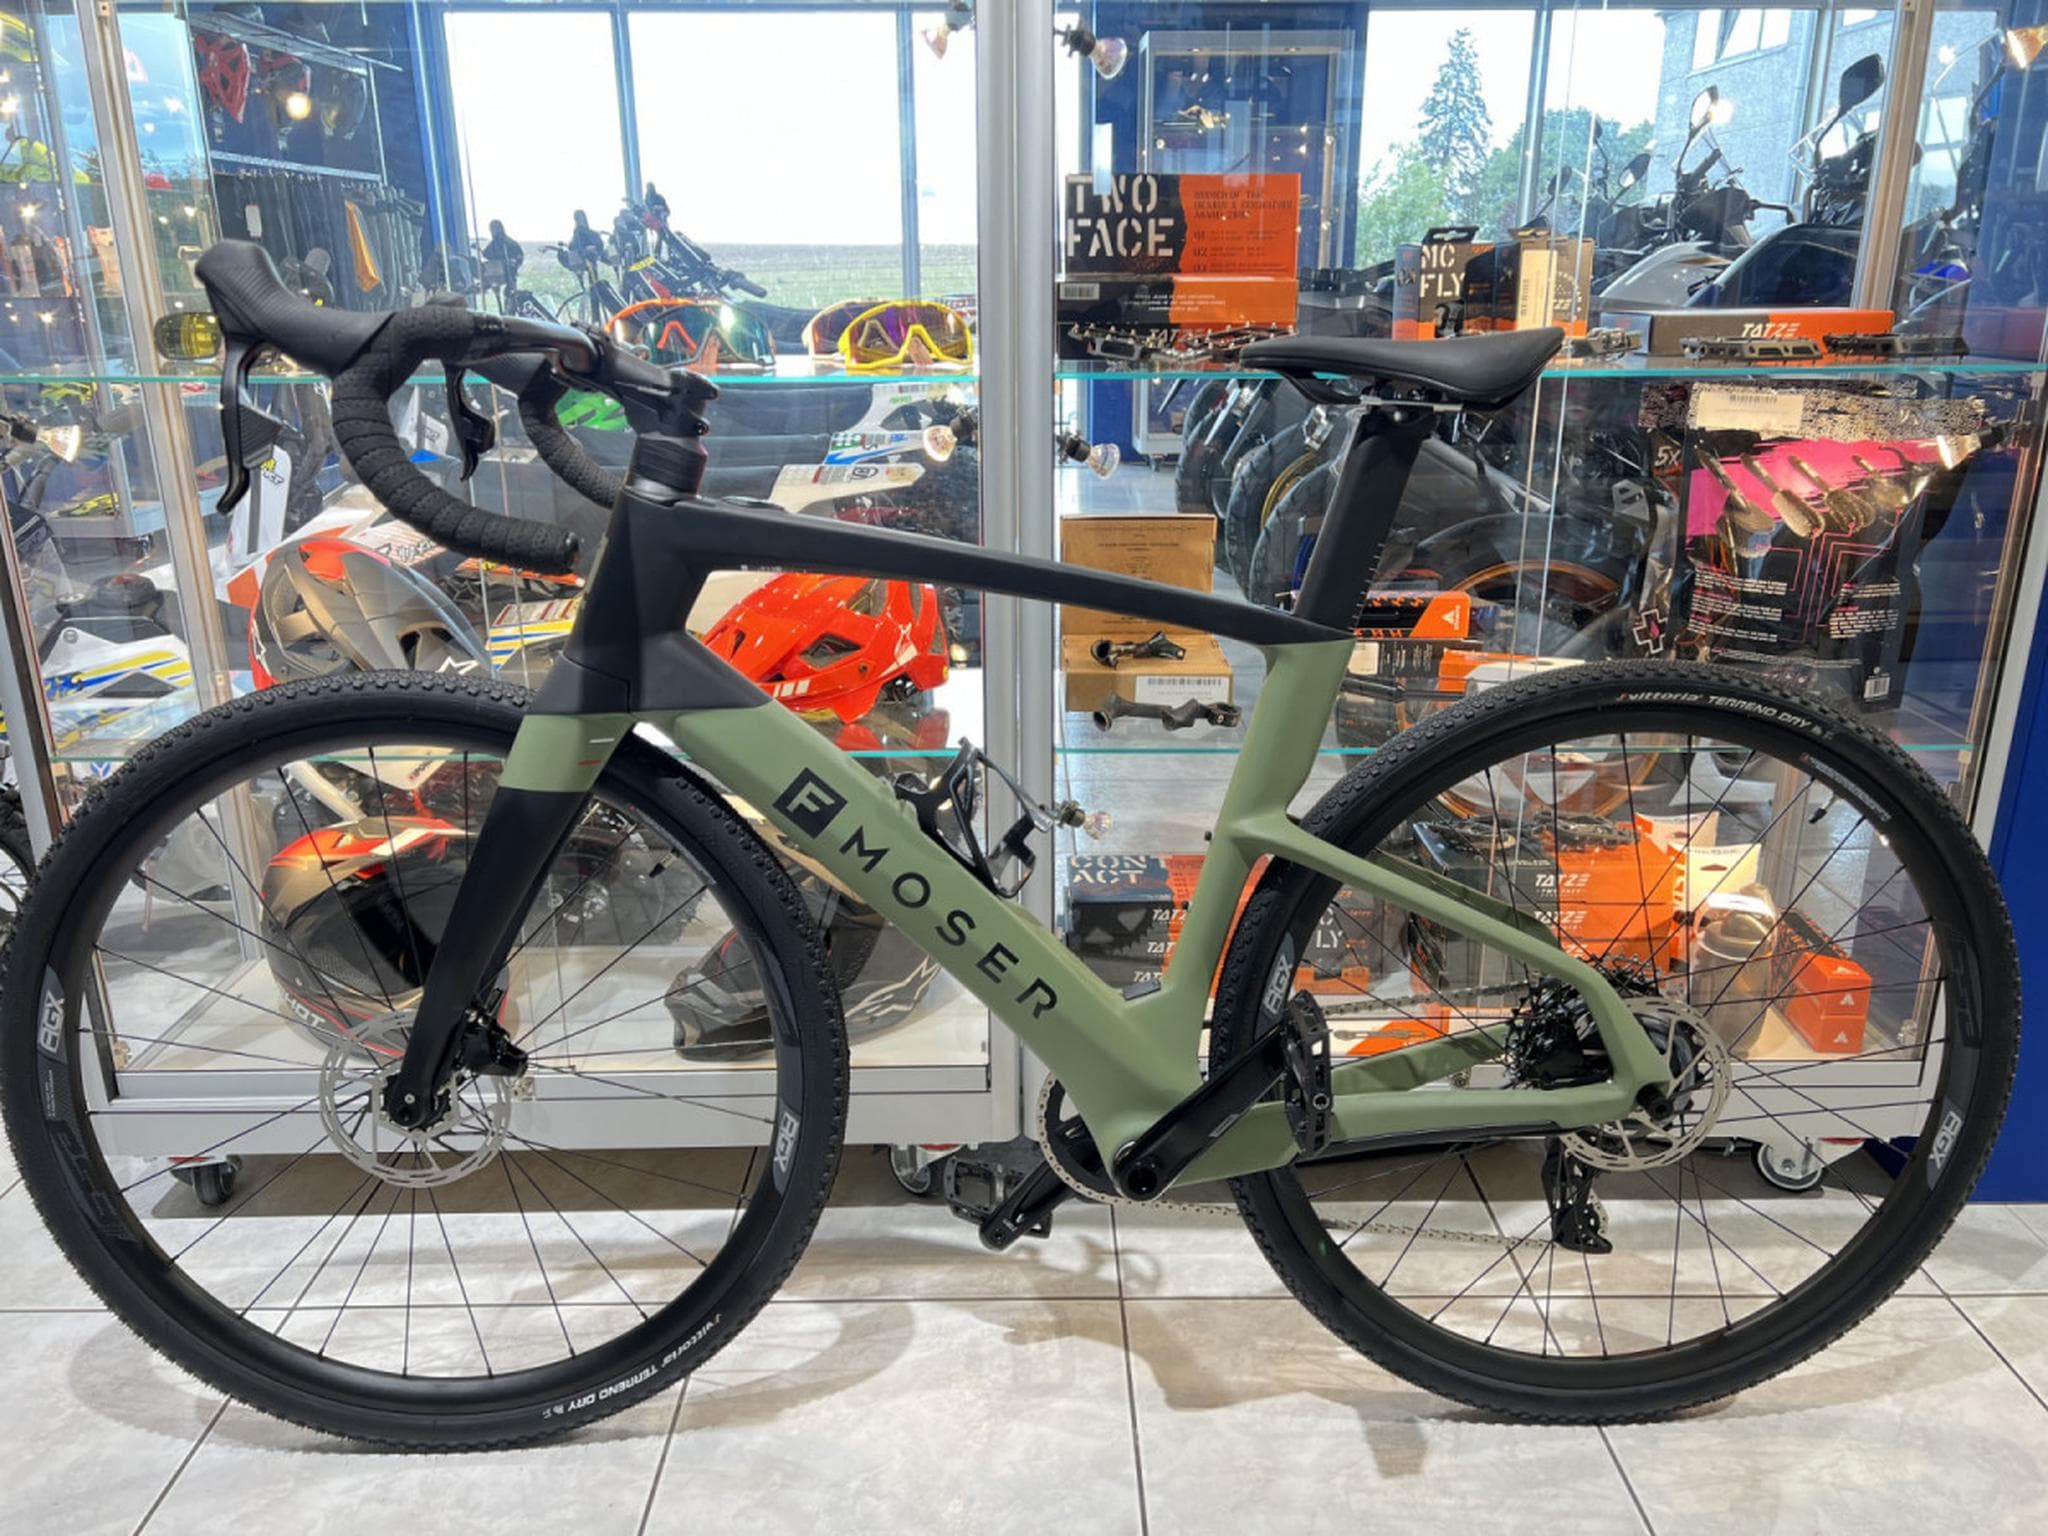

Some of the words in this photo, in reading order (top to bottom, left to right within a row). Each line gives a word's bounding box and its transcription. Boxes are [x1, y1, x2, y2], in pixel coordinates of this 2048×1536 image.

[1066, 175, 1158, 214] TWO
[1067, 218, 1175, 257] FACE
[1421, 244, 1456, 269] MC
[1419, 273, 1465, 298] FLY
[1741, 323, 1801, 339] TATZE
[1628, 691, 1702, 703] vittoria
[1707, 695, 1777, 717] TERRENO
[1778, 710, 1812, 729] DRY
[1073, 869, 1145, 884] ACT
[839, 826, 1058, 1019] MOSER
[1152, 908, 1188, 922] TATZ
[1147, 941, 1178, 953] TAT
[1315, 929, 1344, 948] LY
[1133, 970, 1163, 983] TAT
[598, 1363, 659, 1401] TERRENO
[566, 1394, 597, 1412] DRY
